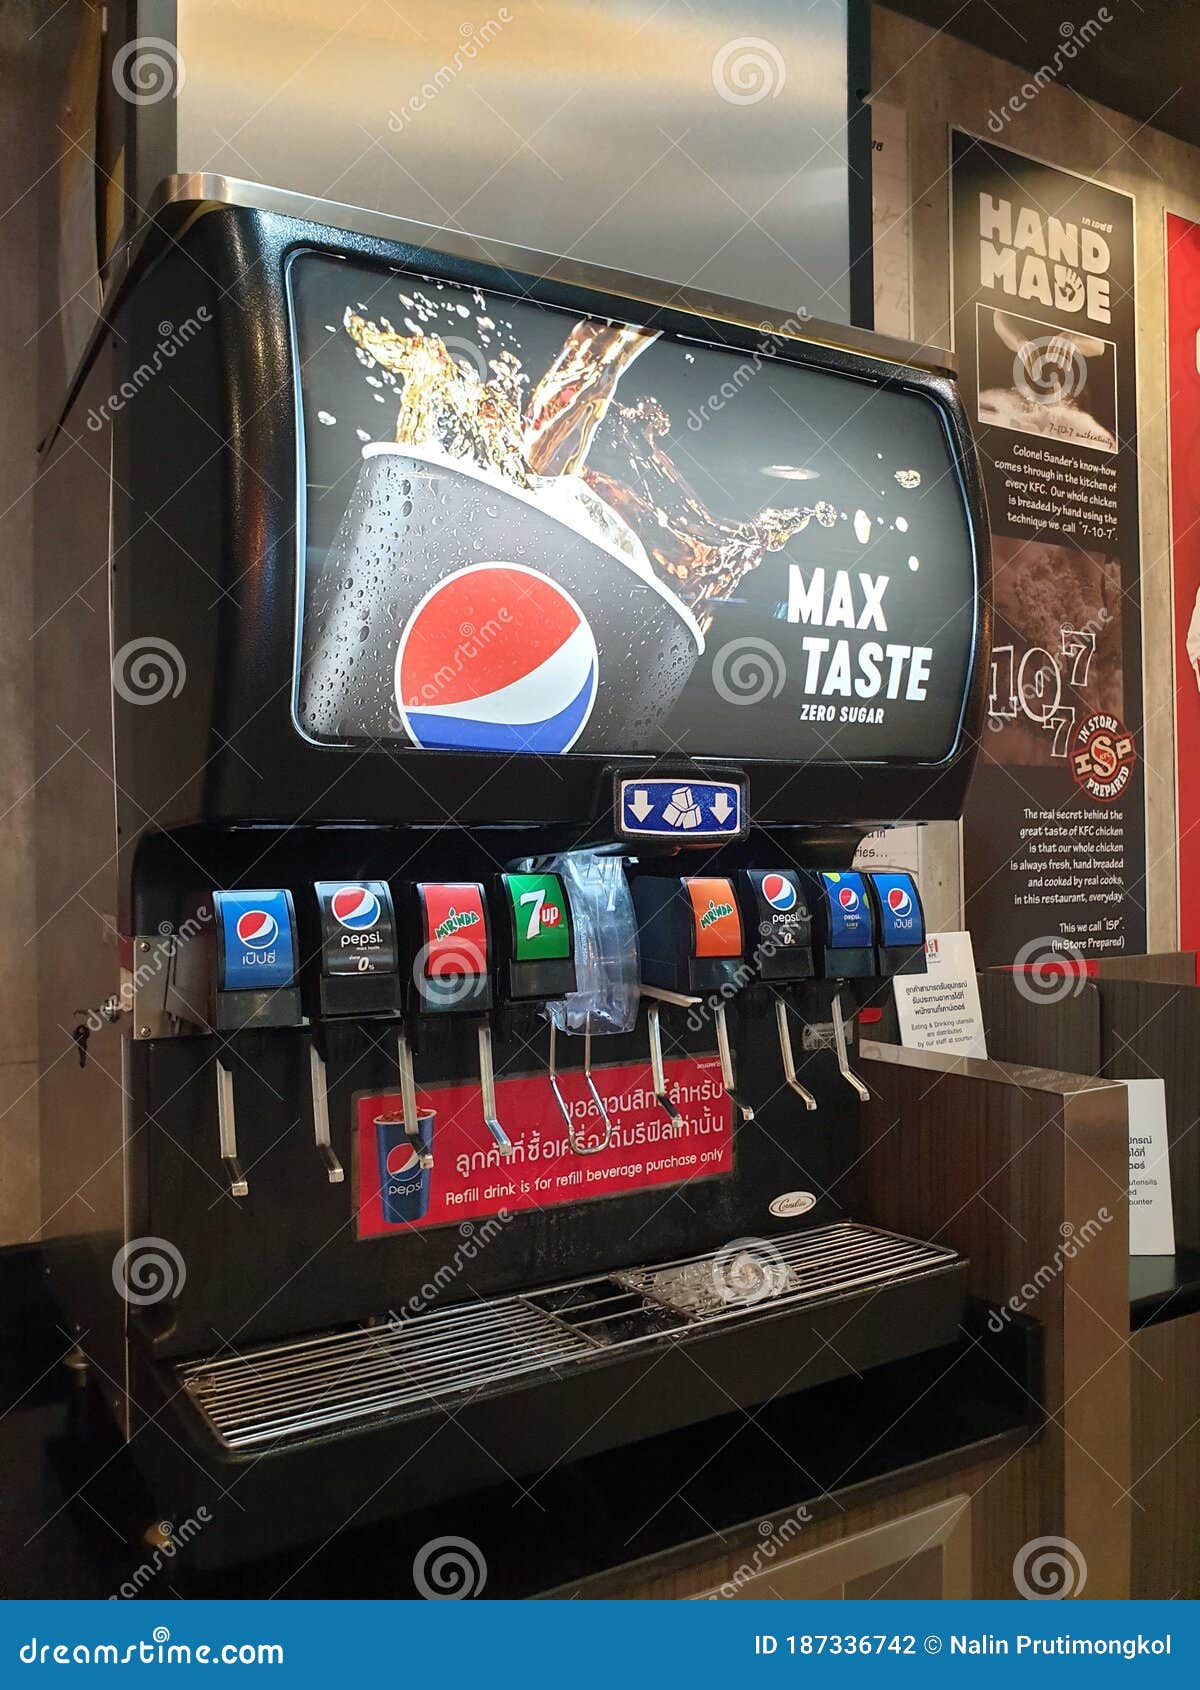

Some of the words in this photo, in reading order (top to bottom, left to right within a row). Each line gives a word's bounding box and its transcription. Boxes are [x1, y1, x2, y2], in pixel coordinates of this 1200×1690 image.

[980, 192, 1110, 274] HAND
[980, 239, 1111, 324] MADE
[1013, 445, 1043, 461] Colonel
[1043, 452, 1079, 469] Sander's
[1080, 460, 1116, 477] know-how
[994, 460, 1022, 472] comes
[1023, 464, 1055, 481] through
[1056, 471, 1064, 481] in
[1065, 473, 1079, 484] the
[1080, 476, 1108, 490] kitchen
[1108, 483, 1117, 493] of
[1005, 479, 1028, 493] every
[1029, 481, 1048, 495] KFC.
[1050, 486, 1066, 497] Our
[1067, 491, 1089, 503] whole
[1089, 495, 1117, 508] chicken
[1007, 512, 1048, 530] technique
[1048, 520, 1060, 530] we
[1062, 521, 1076, 533] call
[1008, 494, 1017, 505] is
[1017, 496, 1051, 512] breaded
[1051, 502, 1062, 516] by
[1062, 505, 1081, 518] hand
[1082, 509, 1103, 525] using
[1104, 514, 1118, 525] the
[787, 564, 890, 632] MAX
[802, 636, 933, 701] TASTE
[1060, 629, 1096, 687] 7
[800, 704, 836, 722] ZERO
[839, 706, 885, 724] SUGAR
[1041, 703, 1075, 758] 7
[1078, 724, 1091, 744] IN
[1088, 714, 1118, 733] STORE
[1086, 765, 1130, 797] PREPARED
[1023, 808, 1038, 819] The
[1039, 809, 1055, 820] real
[1056, 810, 1082, 820] secret
[1083, 809, 1109, 820] behind
[1110, 810, 1123, 820] the
[1020, 826, 1043, 839] great
[1044, 826, 1068, 836] taste
[1068, 825, 1078, 836] of
[1078, 825, 1095, 836] KFC
[1095, 826, 1124, 836] chicken
[1029, 843, 1037, 853] is
[1038, 843, 1057, 853] that
[1058, 844, 1071, 853] our
[1072, 843, 1095, 853] whole
[1095, 842, 1124, 853] chicken
[1010, 860, 1019, 871] is
[1019, 860, 1047, 873] always
[1048, 859, 1072, 871] fresh,
[1073, 859, 1092, 870] hand
[1093, 858, 1124, 869] breaded
[1028, 876, 1043, 888] and
[1044, 875, 1072, 887] cooked
[1073, 875, 1084, 888] by
[1084, 875, 1099, 886] real
[1100, 875, 1124, 886] cooks,
[1014, 894, 1022, 905] in
[1023, 893, 1041, 905] this
[1041, 893, 1088, 905] restaurant,
[1088, 891, 1124, 904] everyday.
[434, 907, 480, 942] MIRINDA
[700, 900, 734, 929] MIRINDA
[1059, 922, 1076, 934] This
[1077, 923, 1088, 933] we
[1088, 920, 1102, 932] call
[1051, 939, 1063, 954] (In
[1063, 939, 1087, 950] Store
[1087, 936, 1125, 951] Prepared)
[911, 1023, 928, 1031] Eating
[934, 1020, 955, 1028] Drinking
[445, 1187, 479, 1206] Refill
[484, 1182, 516, 1200] drink
[520, 1180, 530, 1193] is
[534, 1177, 552, 1191] for
[556, 1170, 583, 1187] refill
[586, 1162, 642, 1182] beverage
[646, 1152, 697, 1174] purchase
[701, 1148, 723, 1165] only
